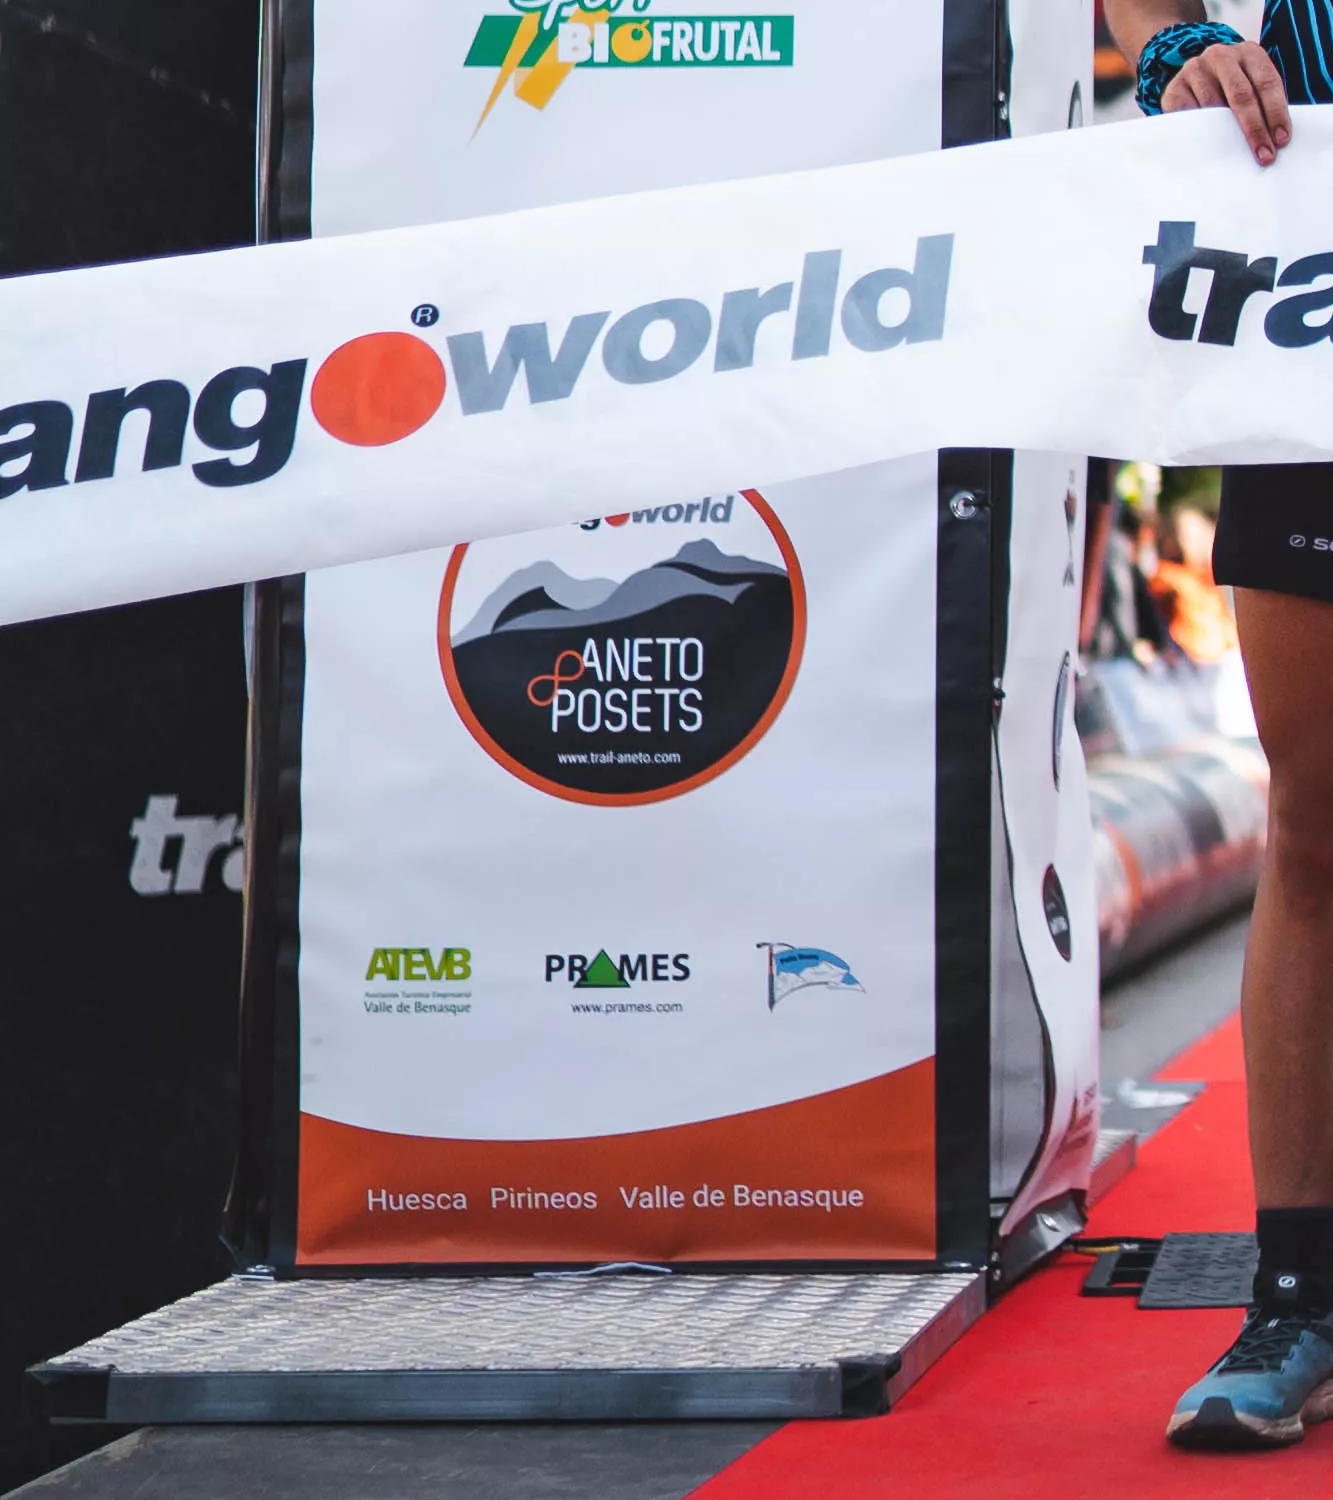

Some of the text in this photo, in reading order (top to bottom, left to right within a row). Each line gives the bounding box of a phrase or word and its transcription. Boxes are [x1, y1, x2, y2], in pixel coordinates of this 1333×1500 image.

[0, 232, 955, 501] angoworld
[582, 637, 704, 682] ANETO
[551, 688, 704, 733] POSETS
[557, 749, 681, 766] www.trail-aneto.com
[364, 1001, 472, 1016] Valle de Benasque
[571, 1001, 683, 1016] www.prames.com
[367, 1184, 864, 1213] Huesca Pirineos Valle de Benasque
